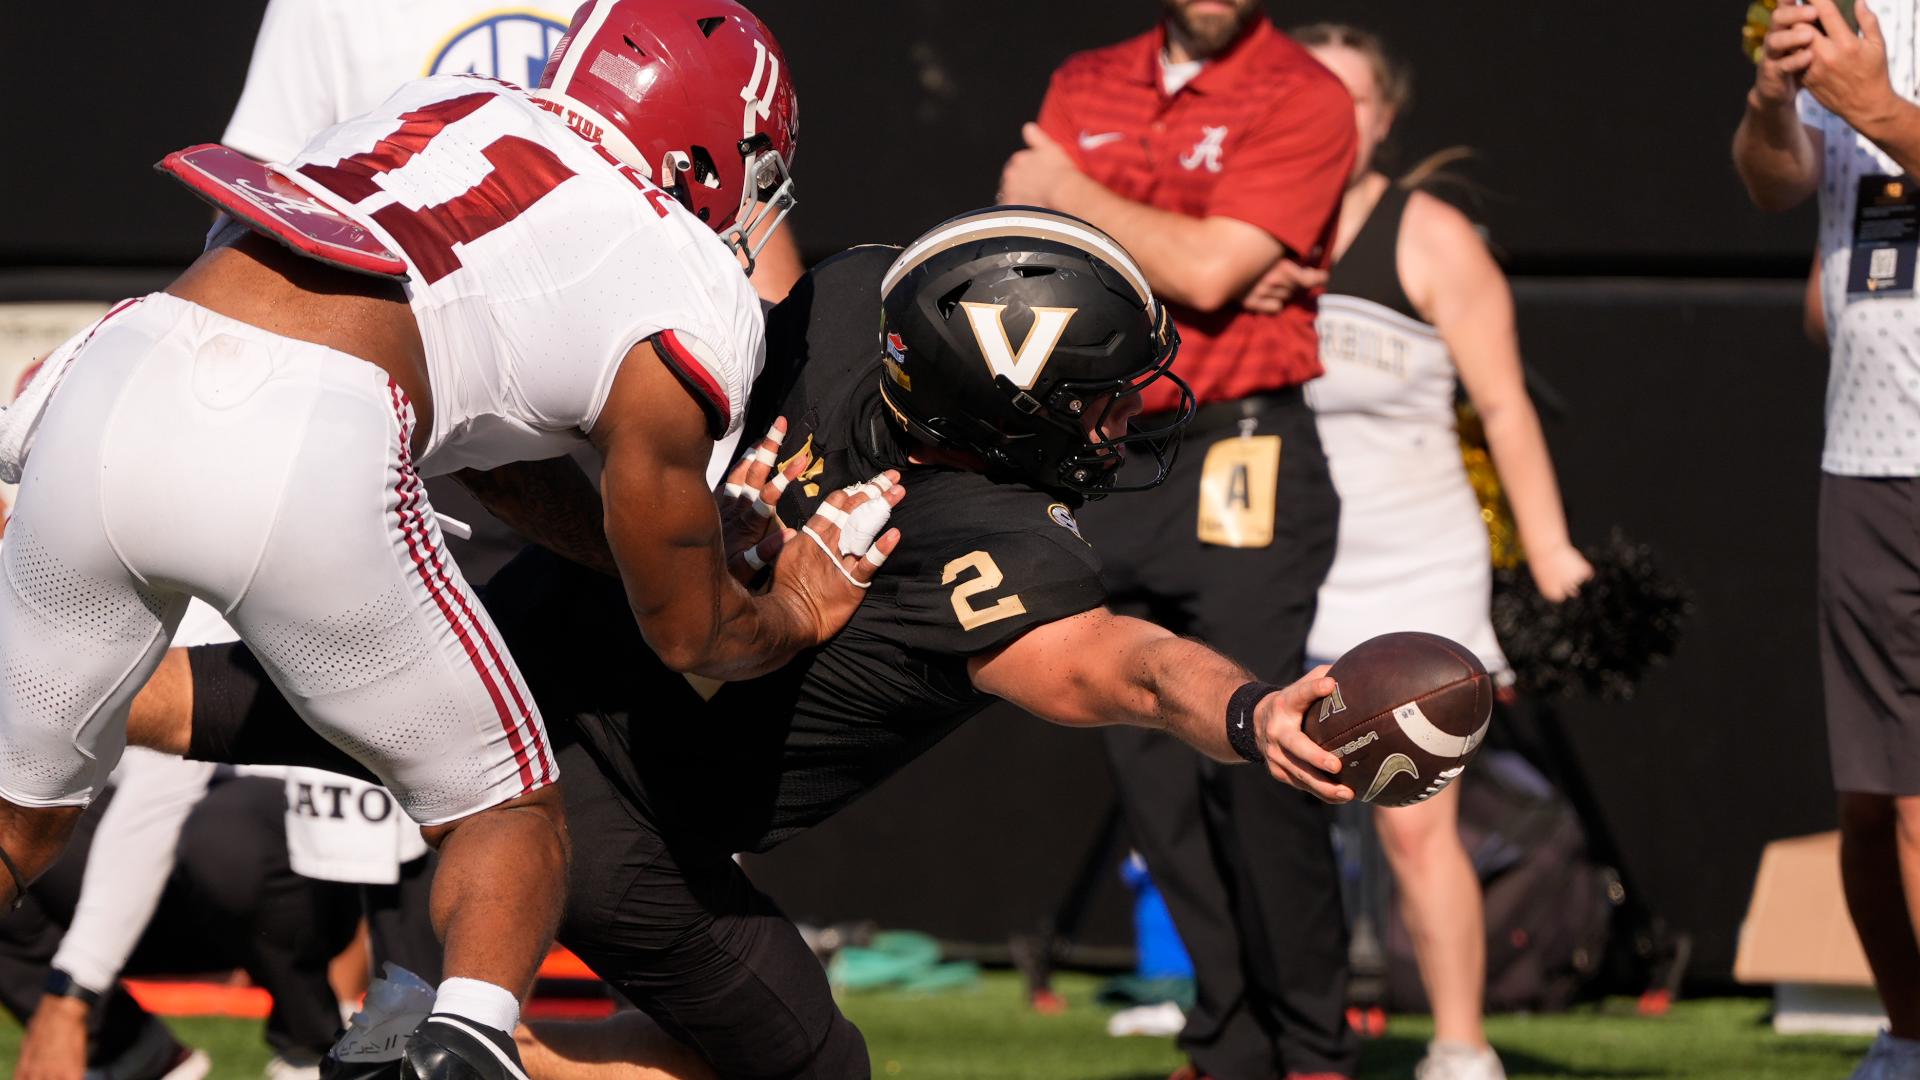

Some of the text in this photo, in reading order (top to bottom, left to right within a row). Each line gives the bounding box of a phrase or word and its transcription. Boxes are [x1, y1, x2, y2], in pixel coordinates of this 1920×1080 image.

[740, 38, 779, 121] 11
[567, 109, 604, 142] TIDE
[296, 92, 578, 285] 11
[959, 301, 1079, 390] V
[1226, 463, 1250, 510] A
[941, 551, 1026, 631] 2
